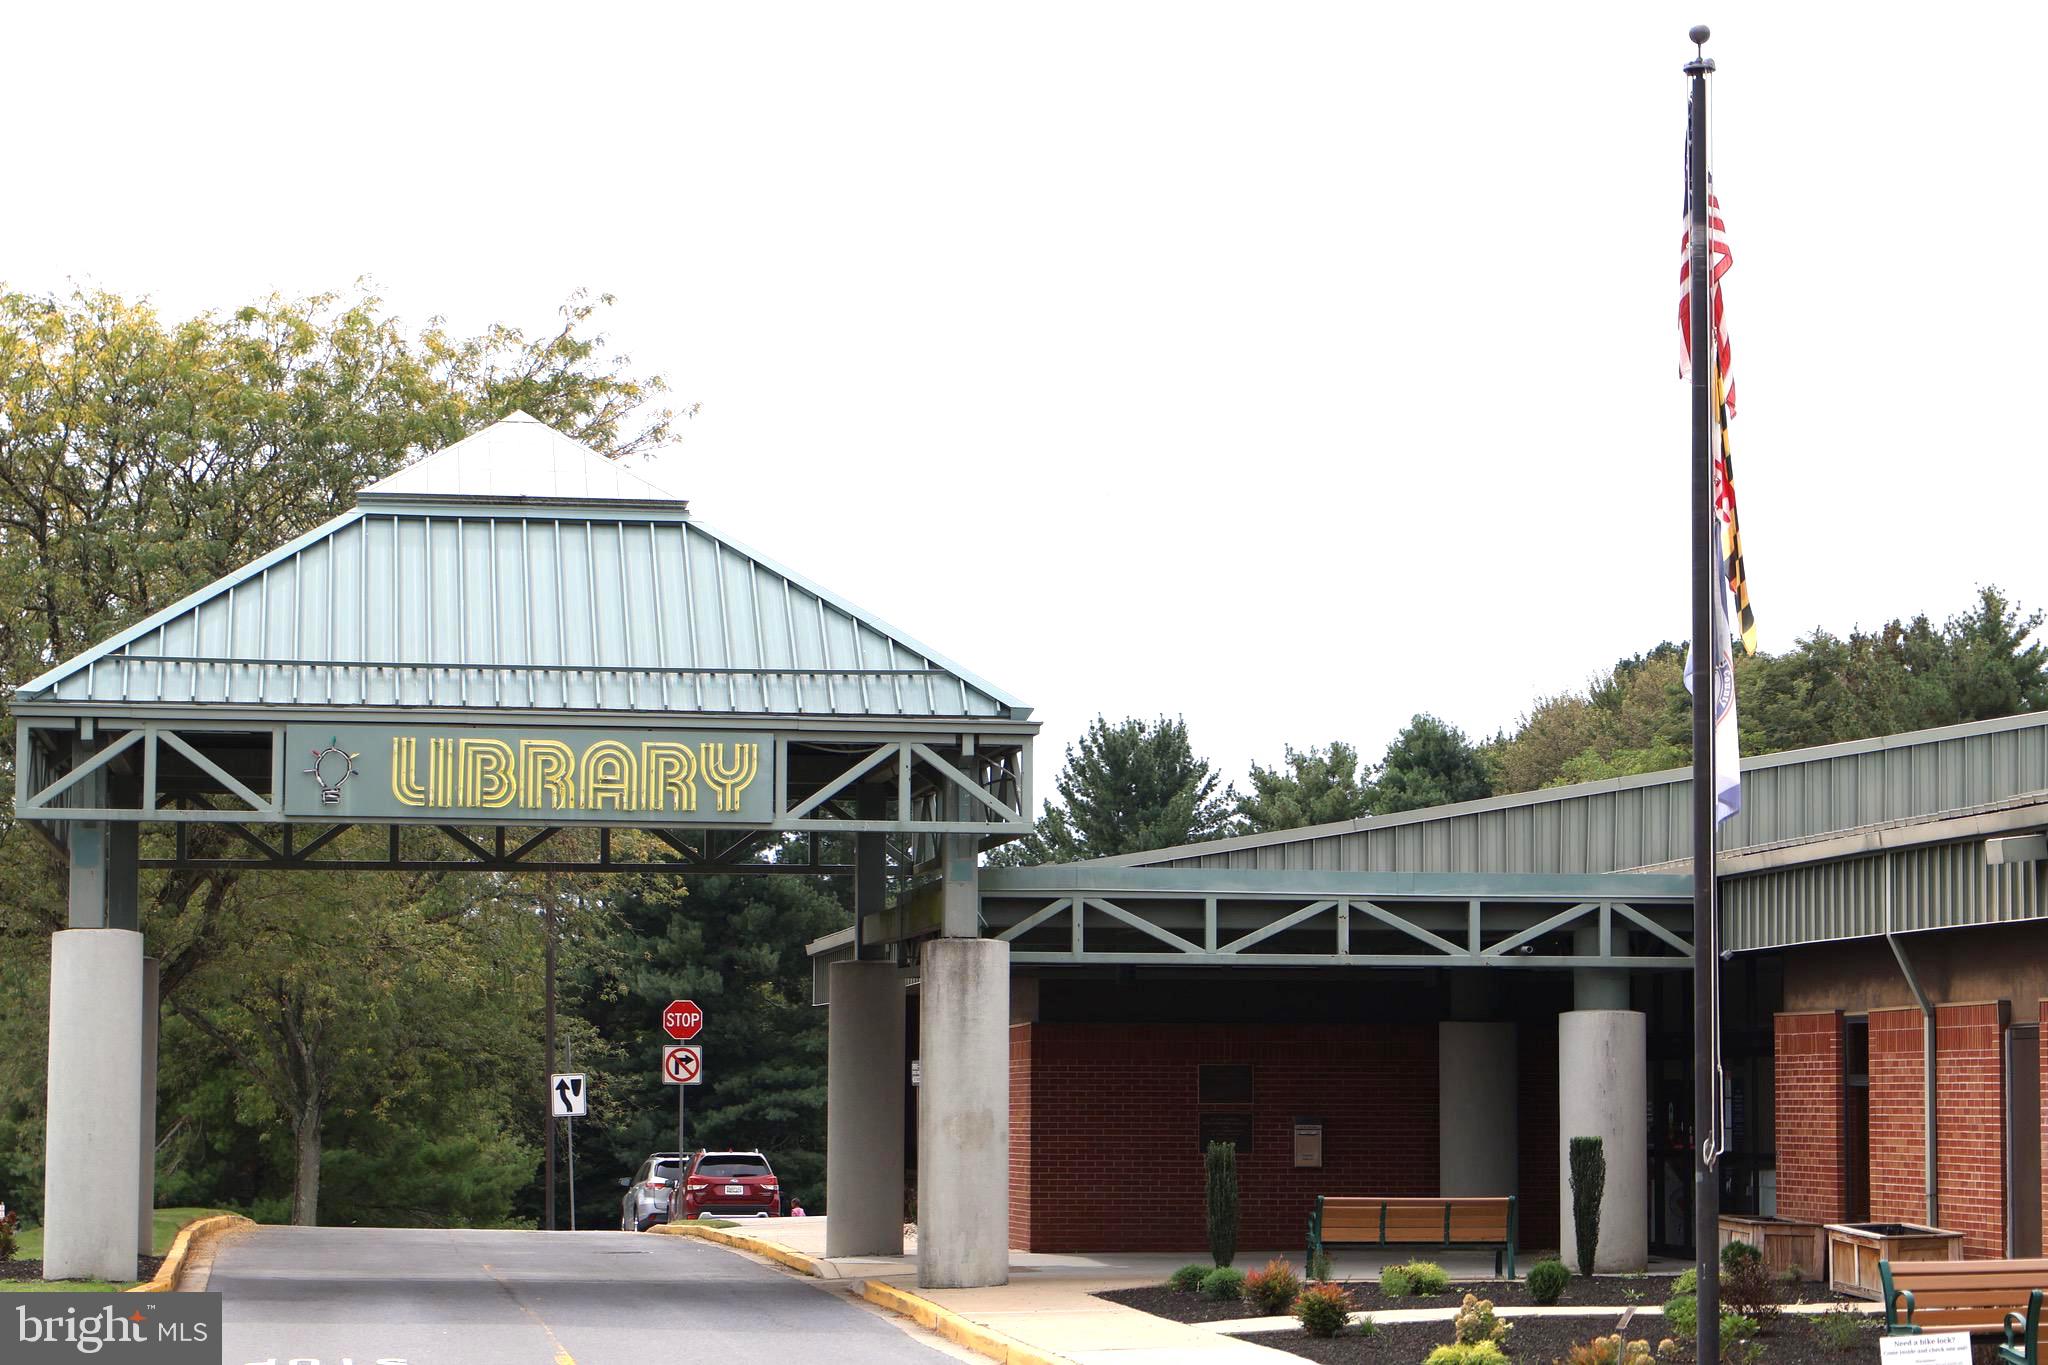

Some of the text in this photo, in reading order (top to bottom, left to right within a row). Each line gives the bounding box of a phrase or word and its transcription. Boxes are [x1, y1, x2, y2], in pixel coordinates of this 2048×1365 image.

[392, 736, 758, 812] LIBRARY
[666, 1012, 700, 1028] STOP
[1937, 1336, 1956, 1344] lock?
